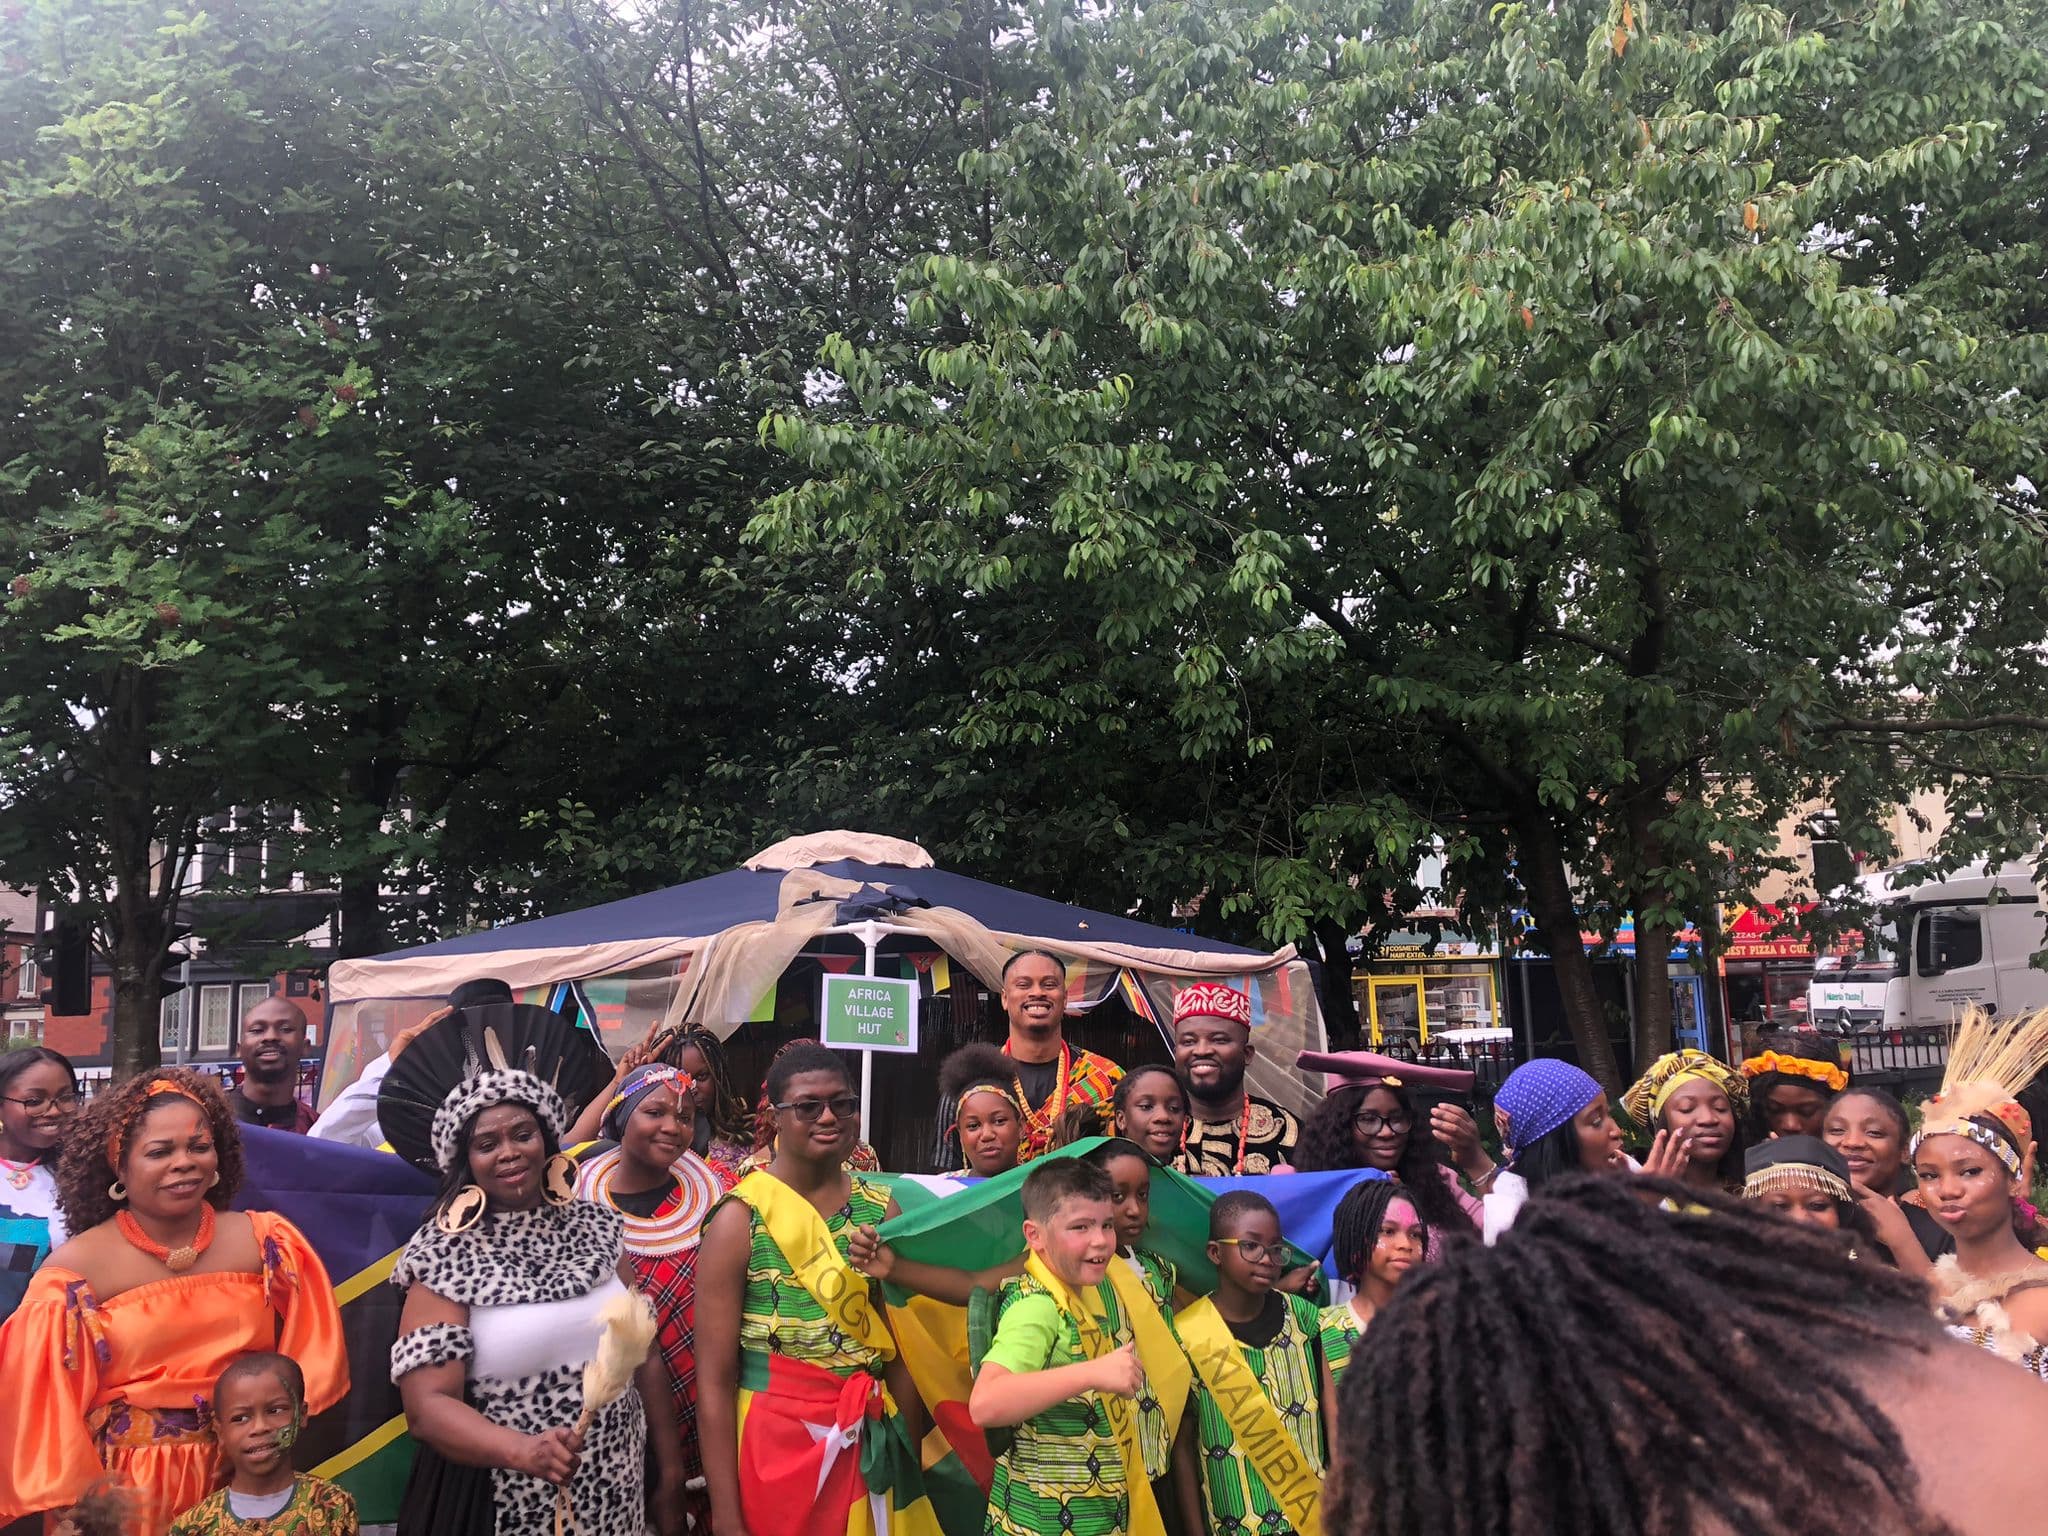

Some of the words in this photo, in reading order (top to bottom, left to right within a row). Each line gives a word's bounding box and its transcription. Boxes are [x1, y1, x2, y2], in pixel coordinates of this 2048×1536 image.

[1749, 945, 1778, 956] PIZZA
[1780, 945, 1787, 955] &
[848, 988, 891, 1002] AFRICA
[844, 1004, 894, 1019] VILLAGE
[857, 1022, 882, 1035] HUT
[1200, 1346, 1318, 1527] NAMIBIA
